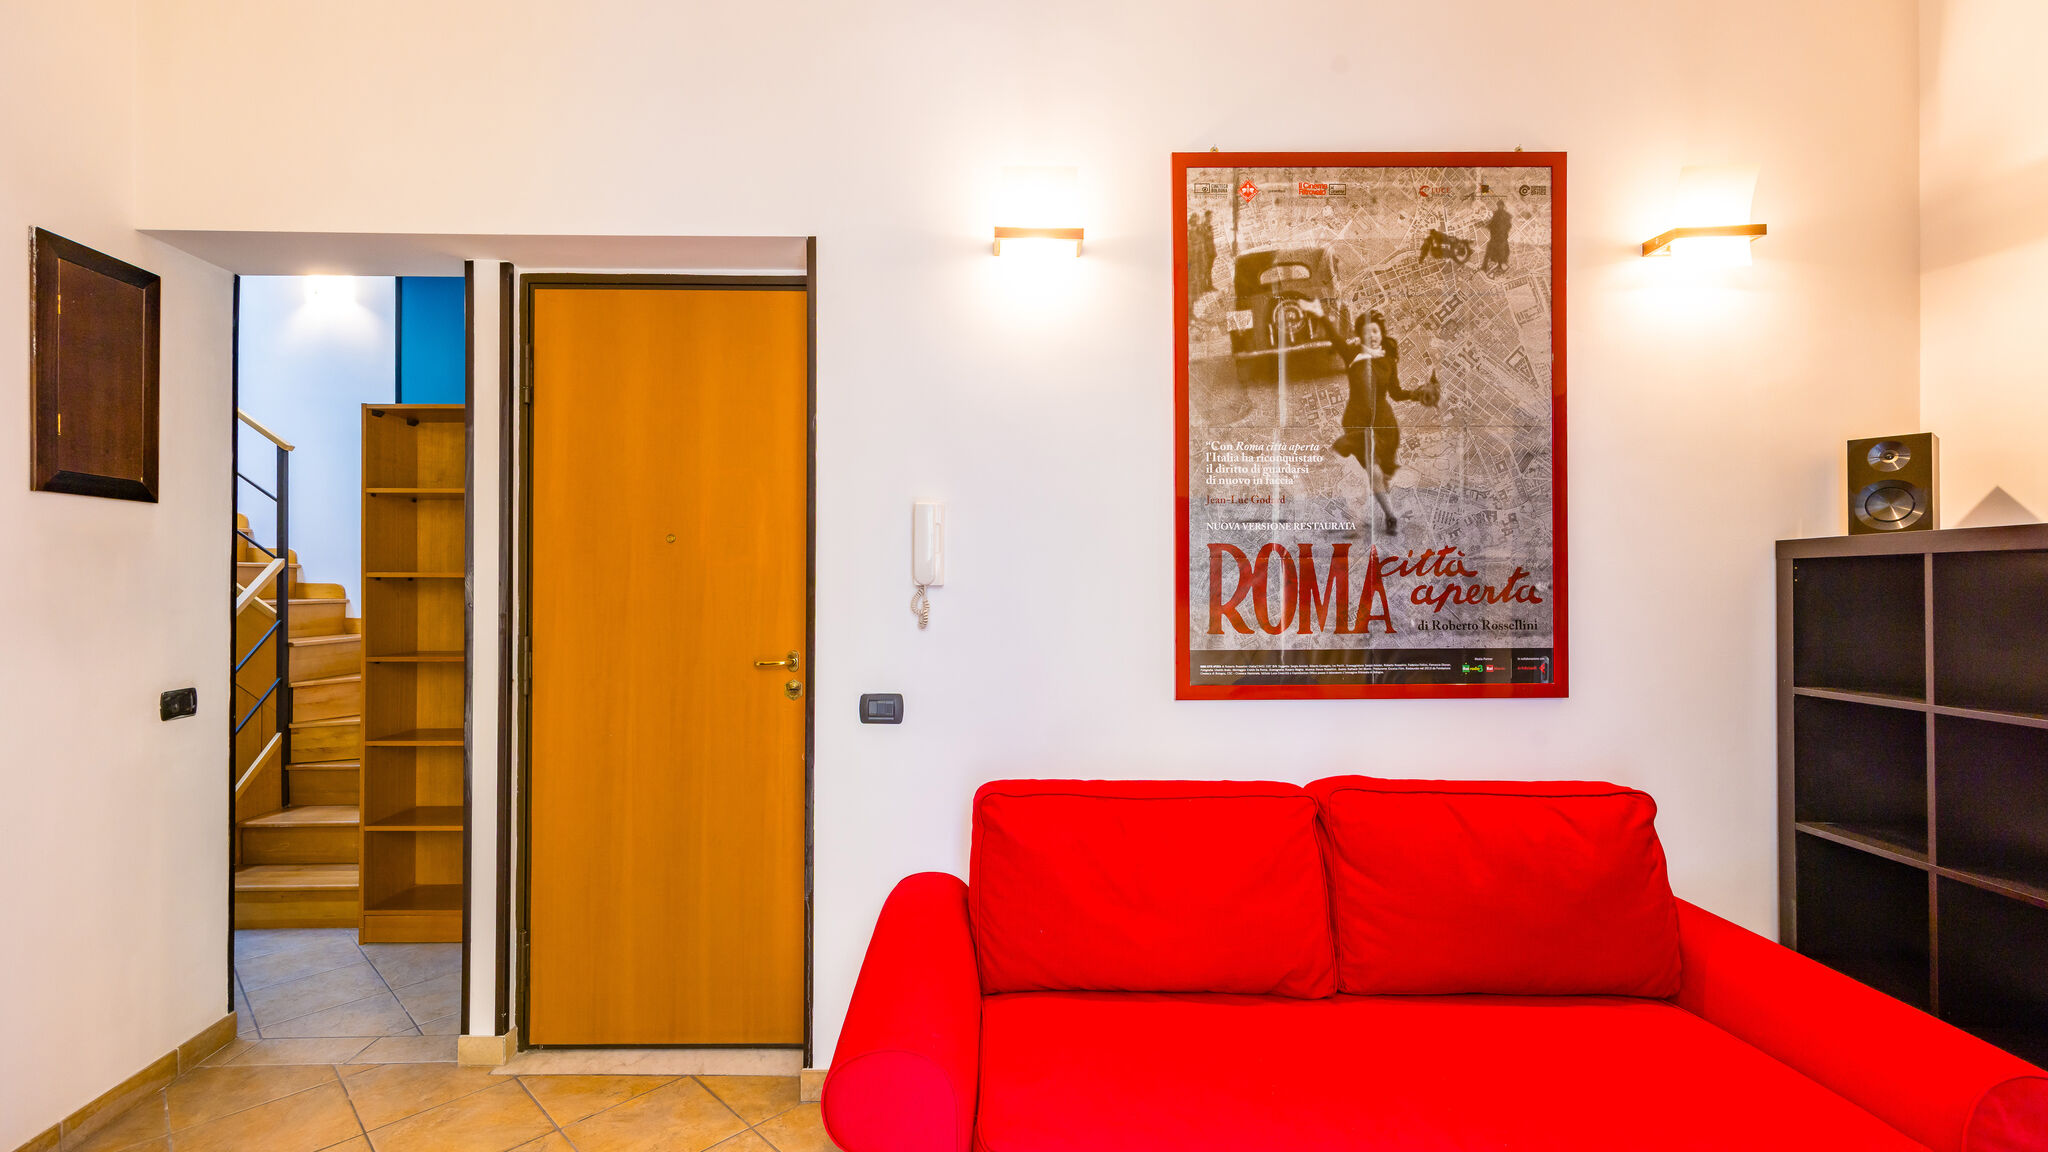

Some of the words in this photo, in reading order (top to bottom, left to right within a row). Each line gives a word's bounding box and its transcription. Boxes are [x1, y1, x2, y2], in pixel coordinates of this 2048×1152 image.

[1236, 442, 1264, 451] Roma
[1289, 444, 1320, 455] aperta
[1206, 452, 1239, 462] l'Italia
[1242, 452, 1254, 462] ha
[1256, 454, 1323, 465] riconquistato
[1206, 464, 1213, 473] il
[1215, 464, 1249, 473] diritto
[1251, 464, 1261, 473] di
[1206, 475, 1216, 484] di
[1253, 476, 1263, 484] in
[1205, 495, 1249, 505] Jean-Luc
[1250, 495, 1286, 505] Godd
[1206, 522, 1241, 531] NUOVA
[1242, 522, 1292, 531] VERSIONE
[1293, 522, 1357, 531] RESTAURATA
[1206, 542, 1398, 635] ROMA
[1377, 545, 1478, 578] città
[1410, 566, 1544, 613] aperta
[1417, 619, 1429, 631] di
[1431, 619, 1479, 631] Roberto
[1481, 619, 1539, 631] Rossellini
